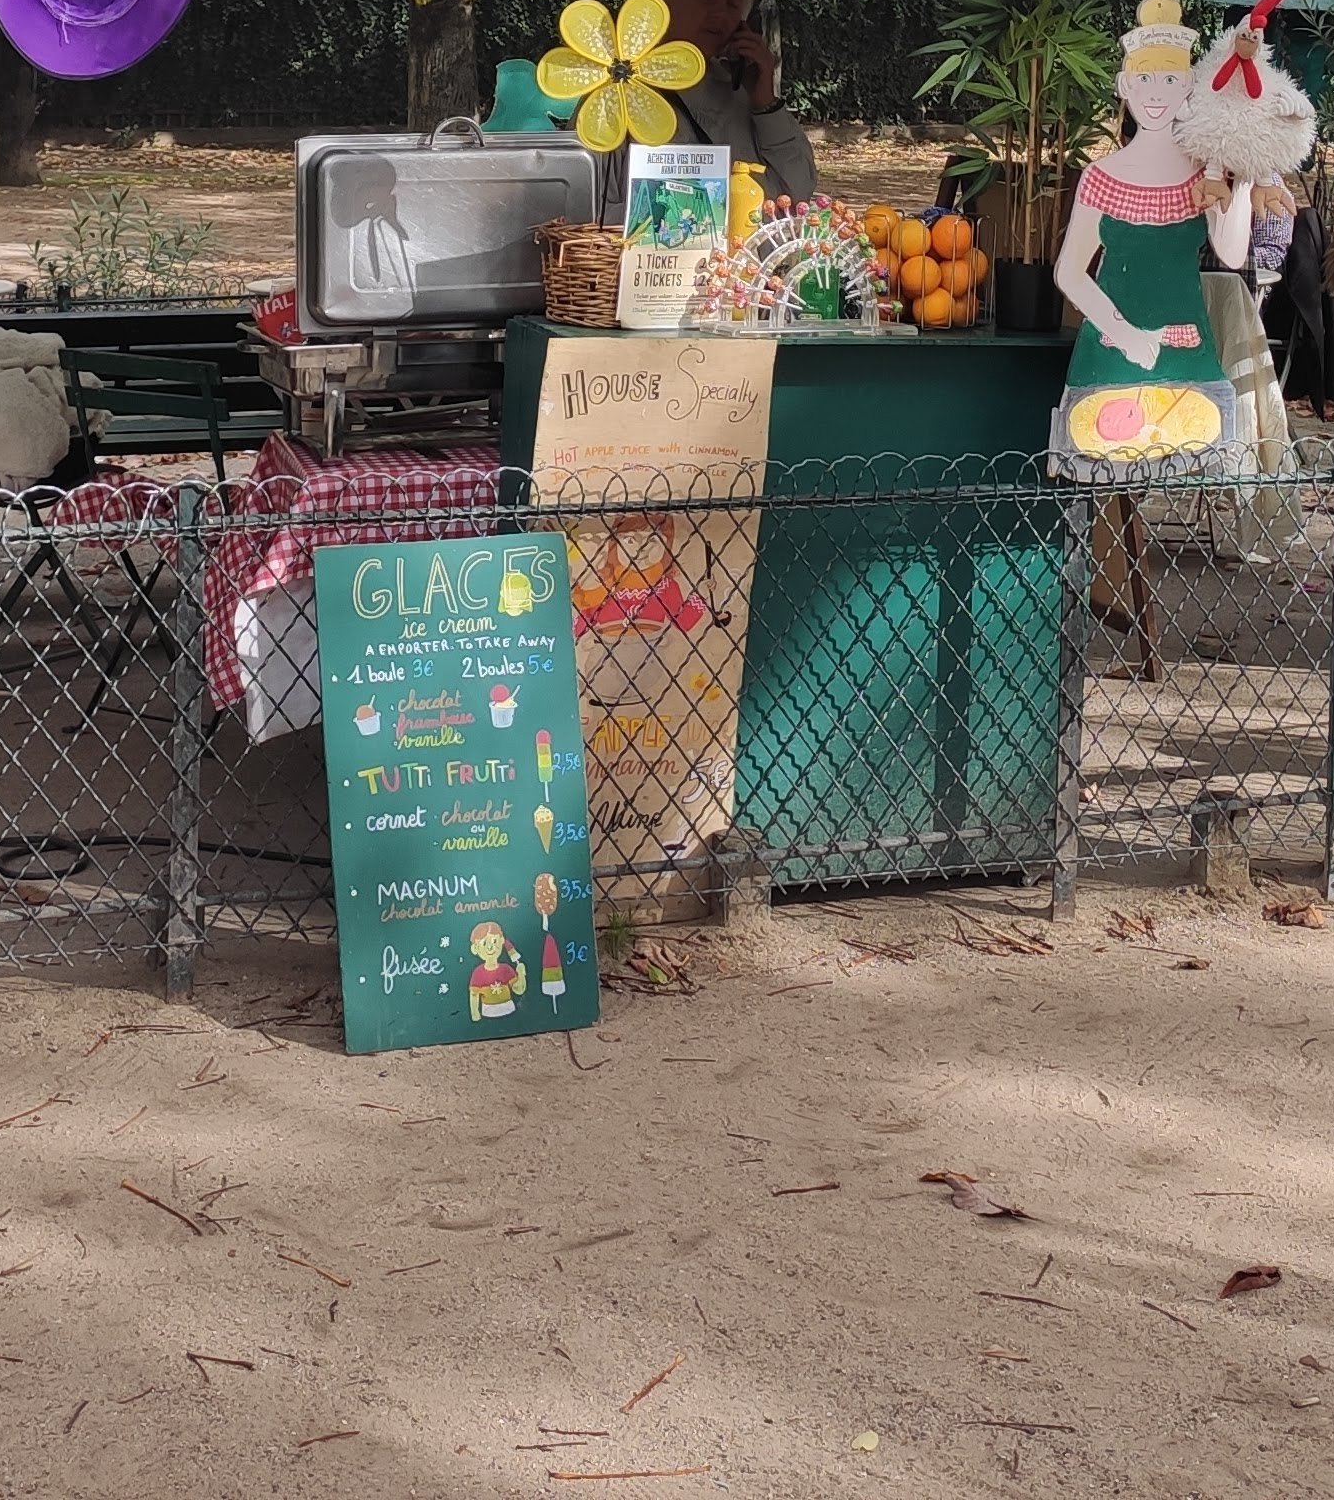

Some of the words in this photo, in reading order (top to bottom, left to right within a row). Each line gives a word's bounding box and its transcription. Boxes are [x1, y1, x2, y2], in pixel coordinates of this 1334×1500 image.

[647, 153, 674, 164] ACHETER
[677, 153, 688, 164] VOS
[690, 153, 714, 164] TICKETS
[647, 253, 679, 269] TICKET
[634, 272, 640, 287] 8
[645, 272, 683, 287] TICKETS
[561, 370, 662, 420] HOUSE
[666, 347, 758, 423] Specialty
[584, 446, 614, 458] APPLE
[353, 546, 556, 619] GLACES
[398, 616, 427, 640] ice
[438, 616, 497, 634] cream
[474, 636, 512, 648] TAKE
[518, 634, 556, 652] AWAY
[347, 664, 363, 684] 1
[368, 661, 406, 683] boule
[412, 658, 434, 678] 3€
[462, 657, 475, 678] 2
[477, 655, 525, 678] boules
[528, 654, 554, 674] 5€
[398, 689, 462, 712] chocolat
[397, 724, 466, 750] vanille
[593, 715, 672, 754] APPLE
[586, 758, 679, 780] innamon
[366, 805, 427, 833] cornet
[441, 800, 512, 824] chocolat
[470, 823, 486, 834] ou
[442, 825, 509, 851] vanille
[378, 875, 479, 904] MAGNUM
[380, 899, 444, 923] chocolat
[566, 941, 588, 965] 3€
[380, 945, 445, 995] fusée
